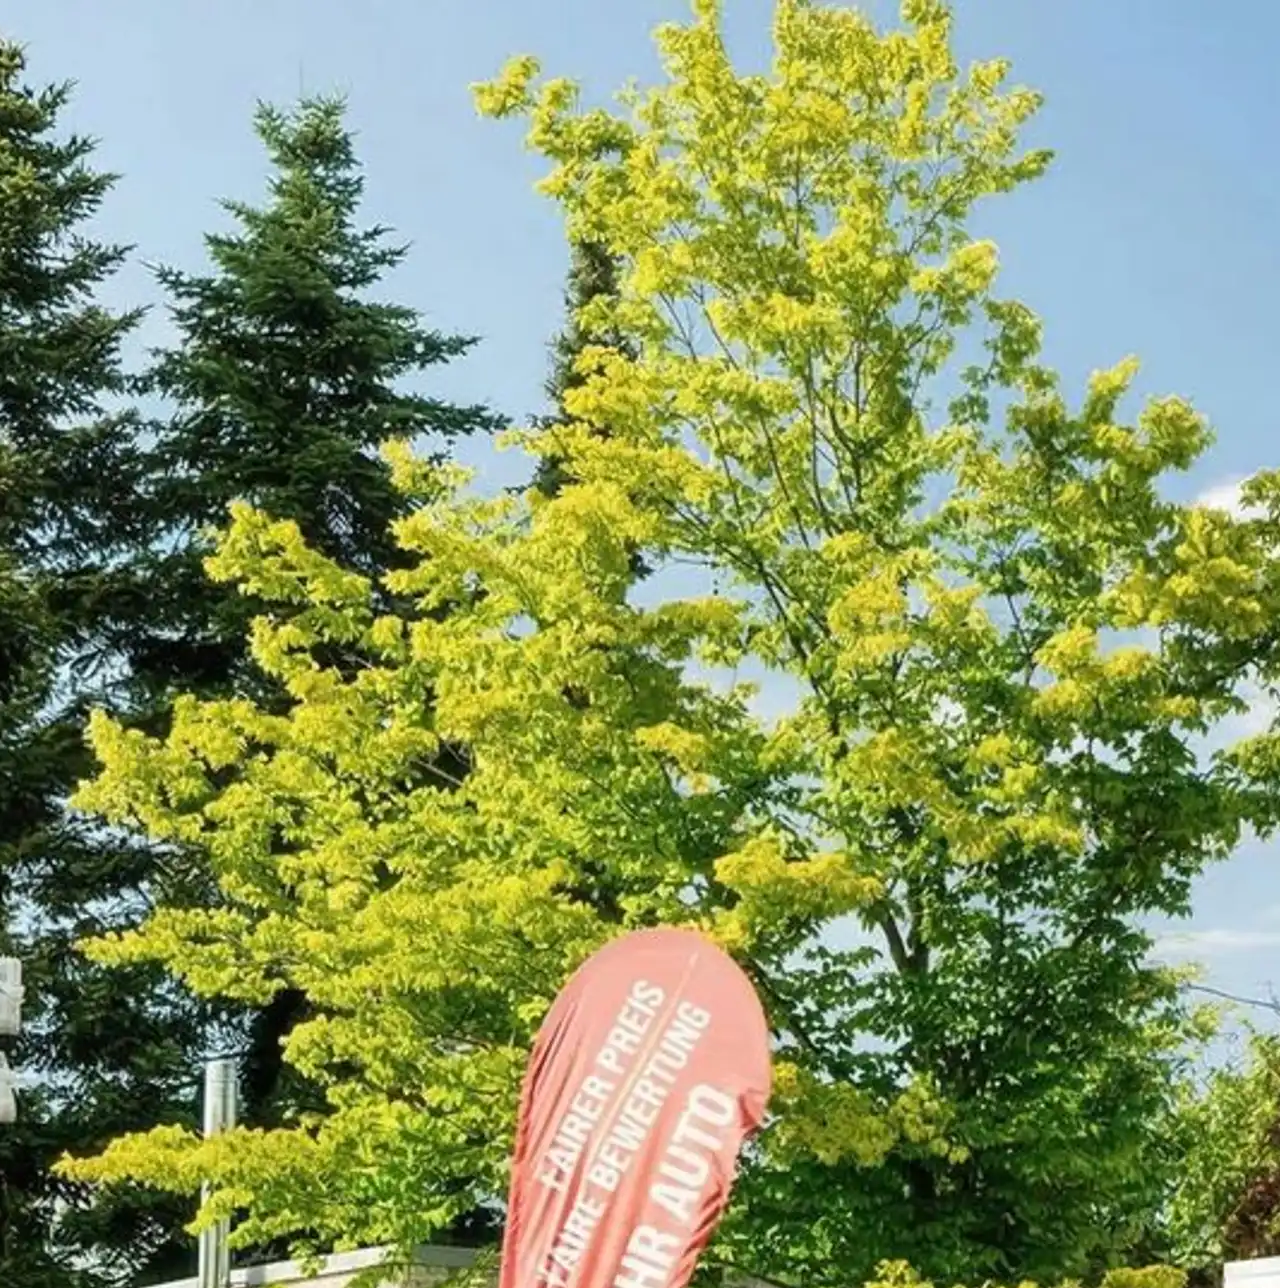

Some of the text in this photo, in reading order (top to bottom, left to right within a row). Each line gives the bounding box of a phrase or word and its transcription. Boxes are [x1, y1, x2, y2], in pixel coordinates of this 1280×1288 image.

[539, 1001, 711, 1287] FAIRE BEWERTUNG
[540, 980, 665, 1192] FAIRER PREIS
[650, 1083, 736, 1223] AUTO
